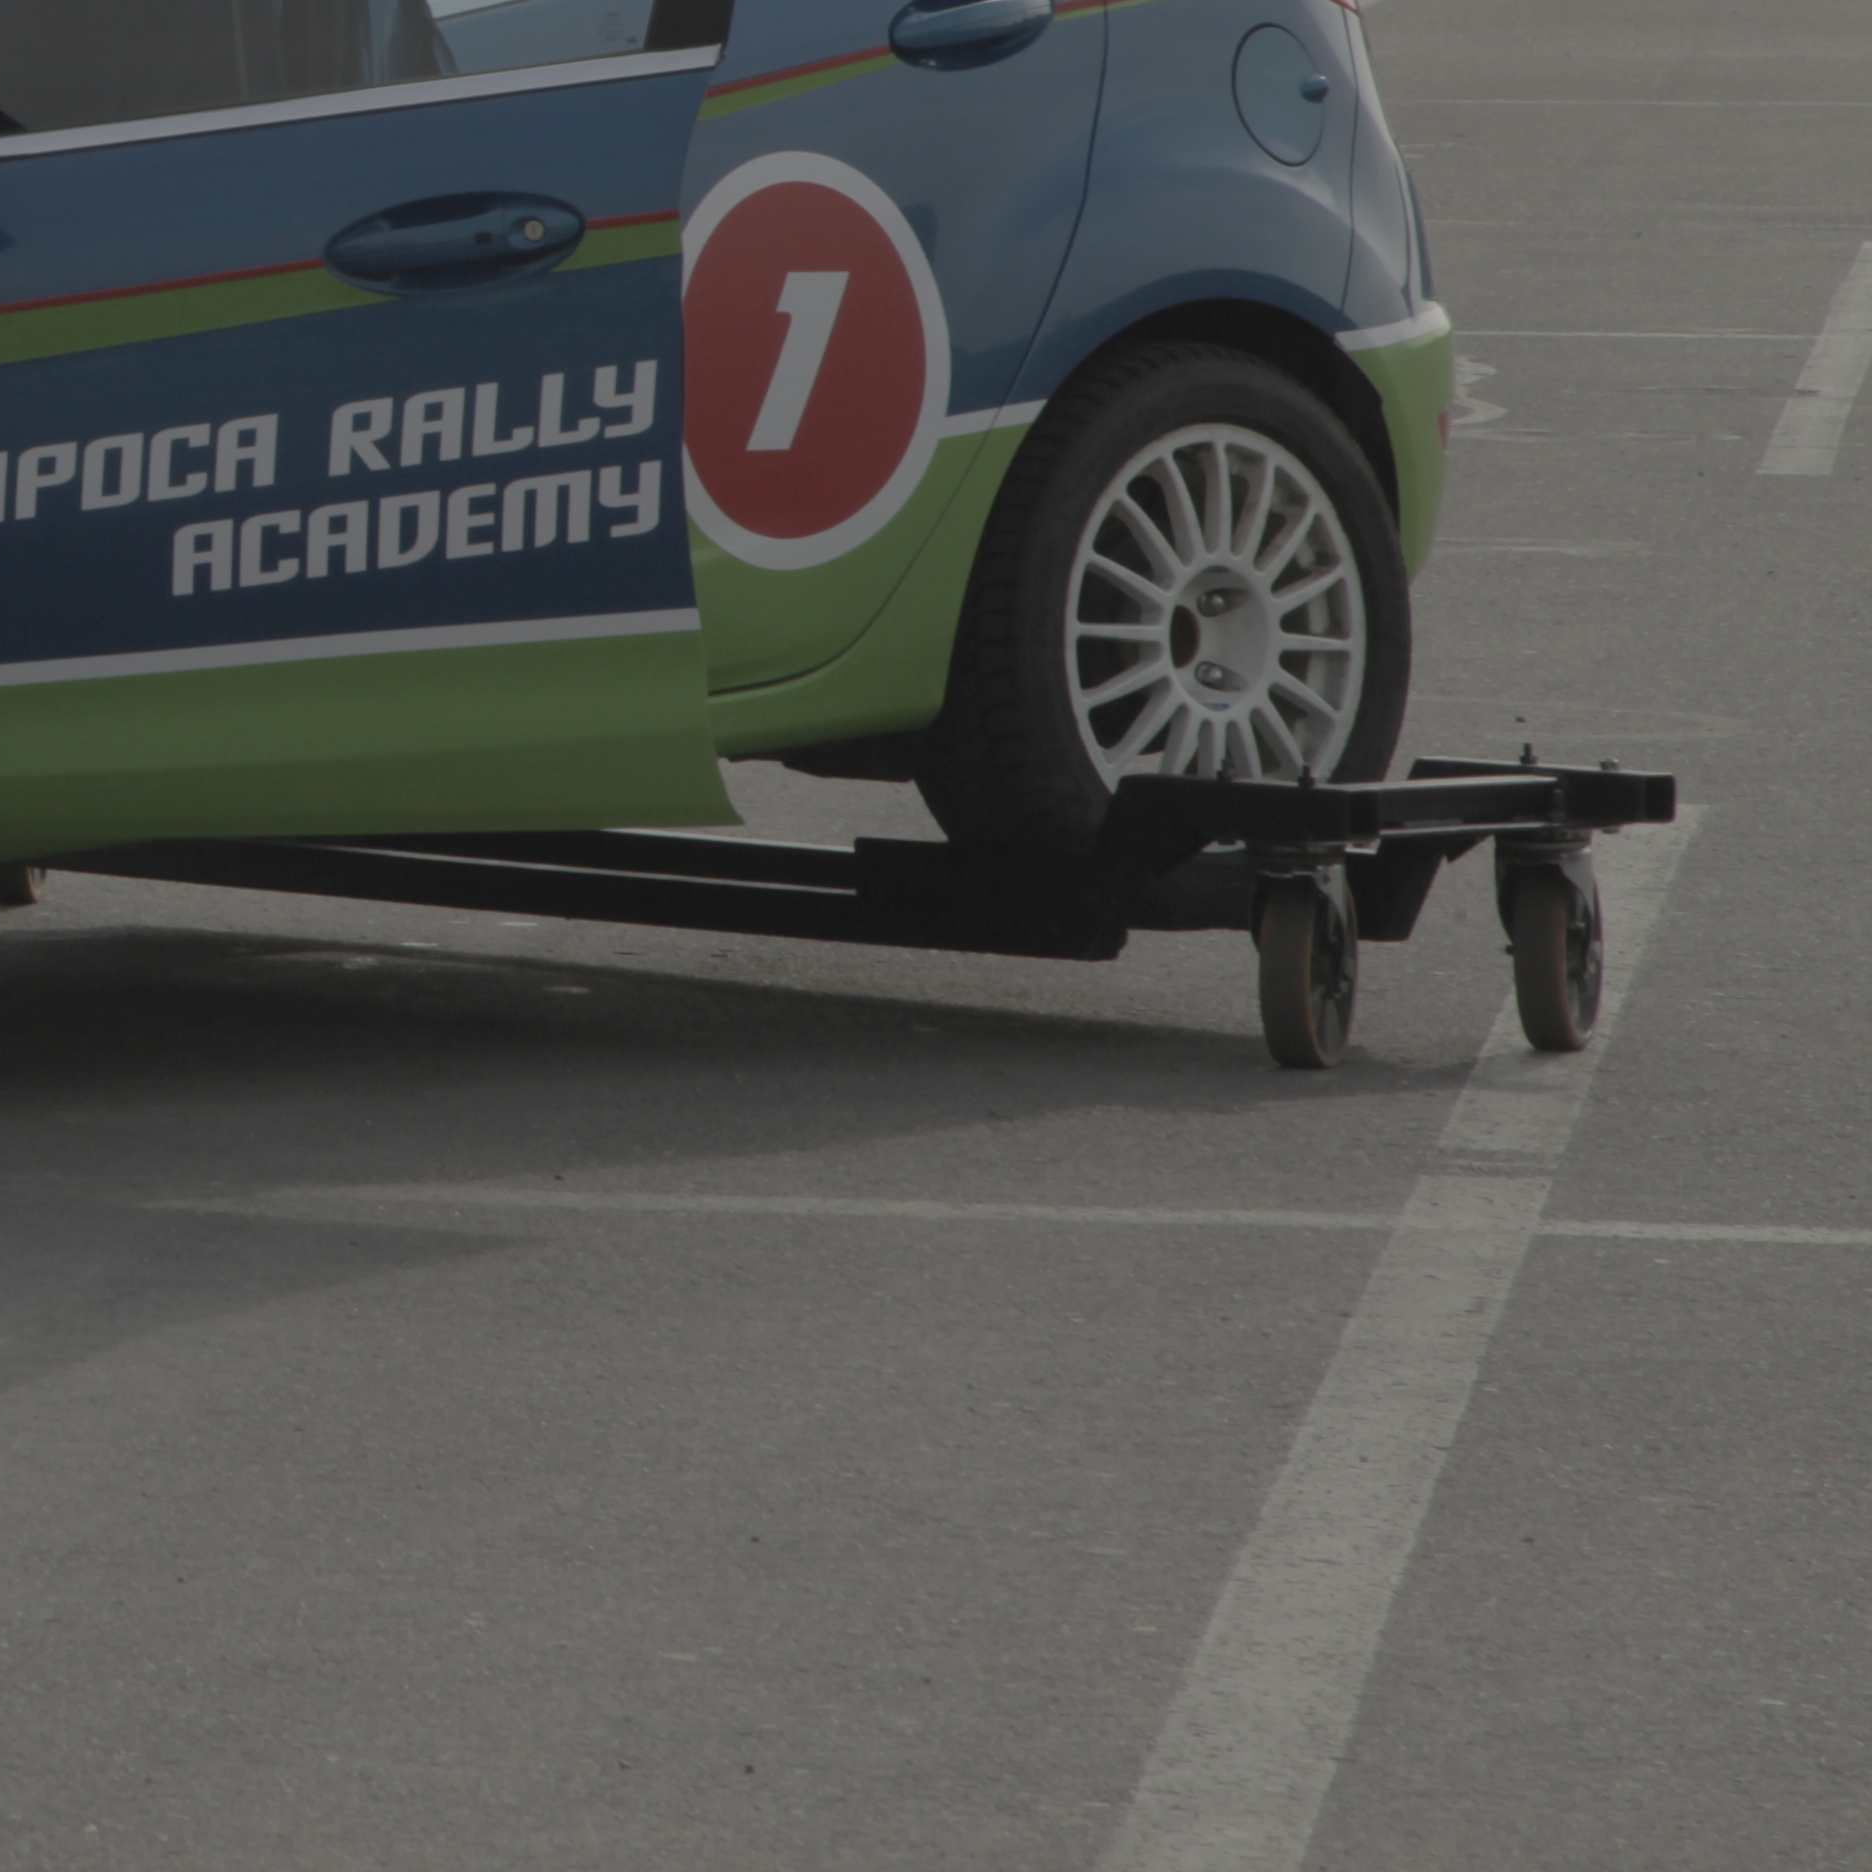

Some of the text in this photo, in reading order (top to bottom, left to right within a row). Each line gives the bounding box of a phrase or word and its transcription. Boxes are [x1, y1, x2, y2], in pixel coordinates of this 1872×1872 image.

[329, 358, 660, 474] RALLY
[747, 270, 850, 452] 1
[170, 458, 665, 598] ACADEMY
